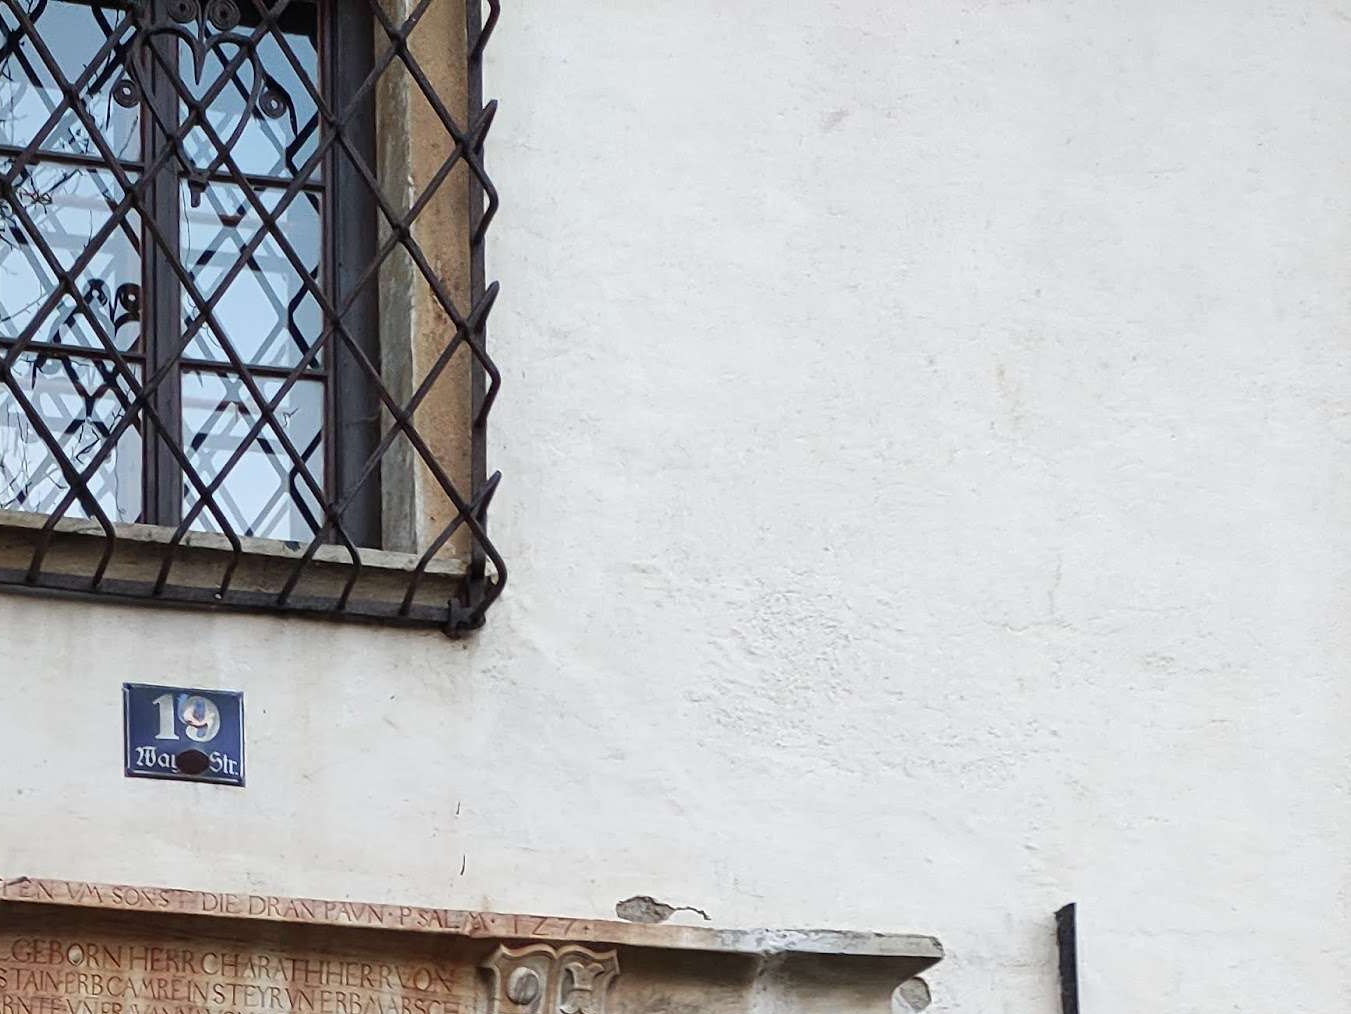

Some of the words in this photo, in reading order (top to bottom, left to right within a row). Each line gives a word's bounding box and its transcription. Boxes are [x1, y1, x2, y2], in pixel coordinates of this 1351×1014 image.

[152, 692, 221, 742] 19
[202, 891, 240, 914] DIE
[129, 946, 196, 975] HERR
